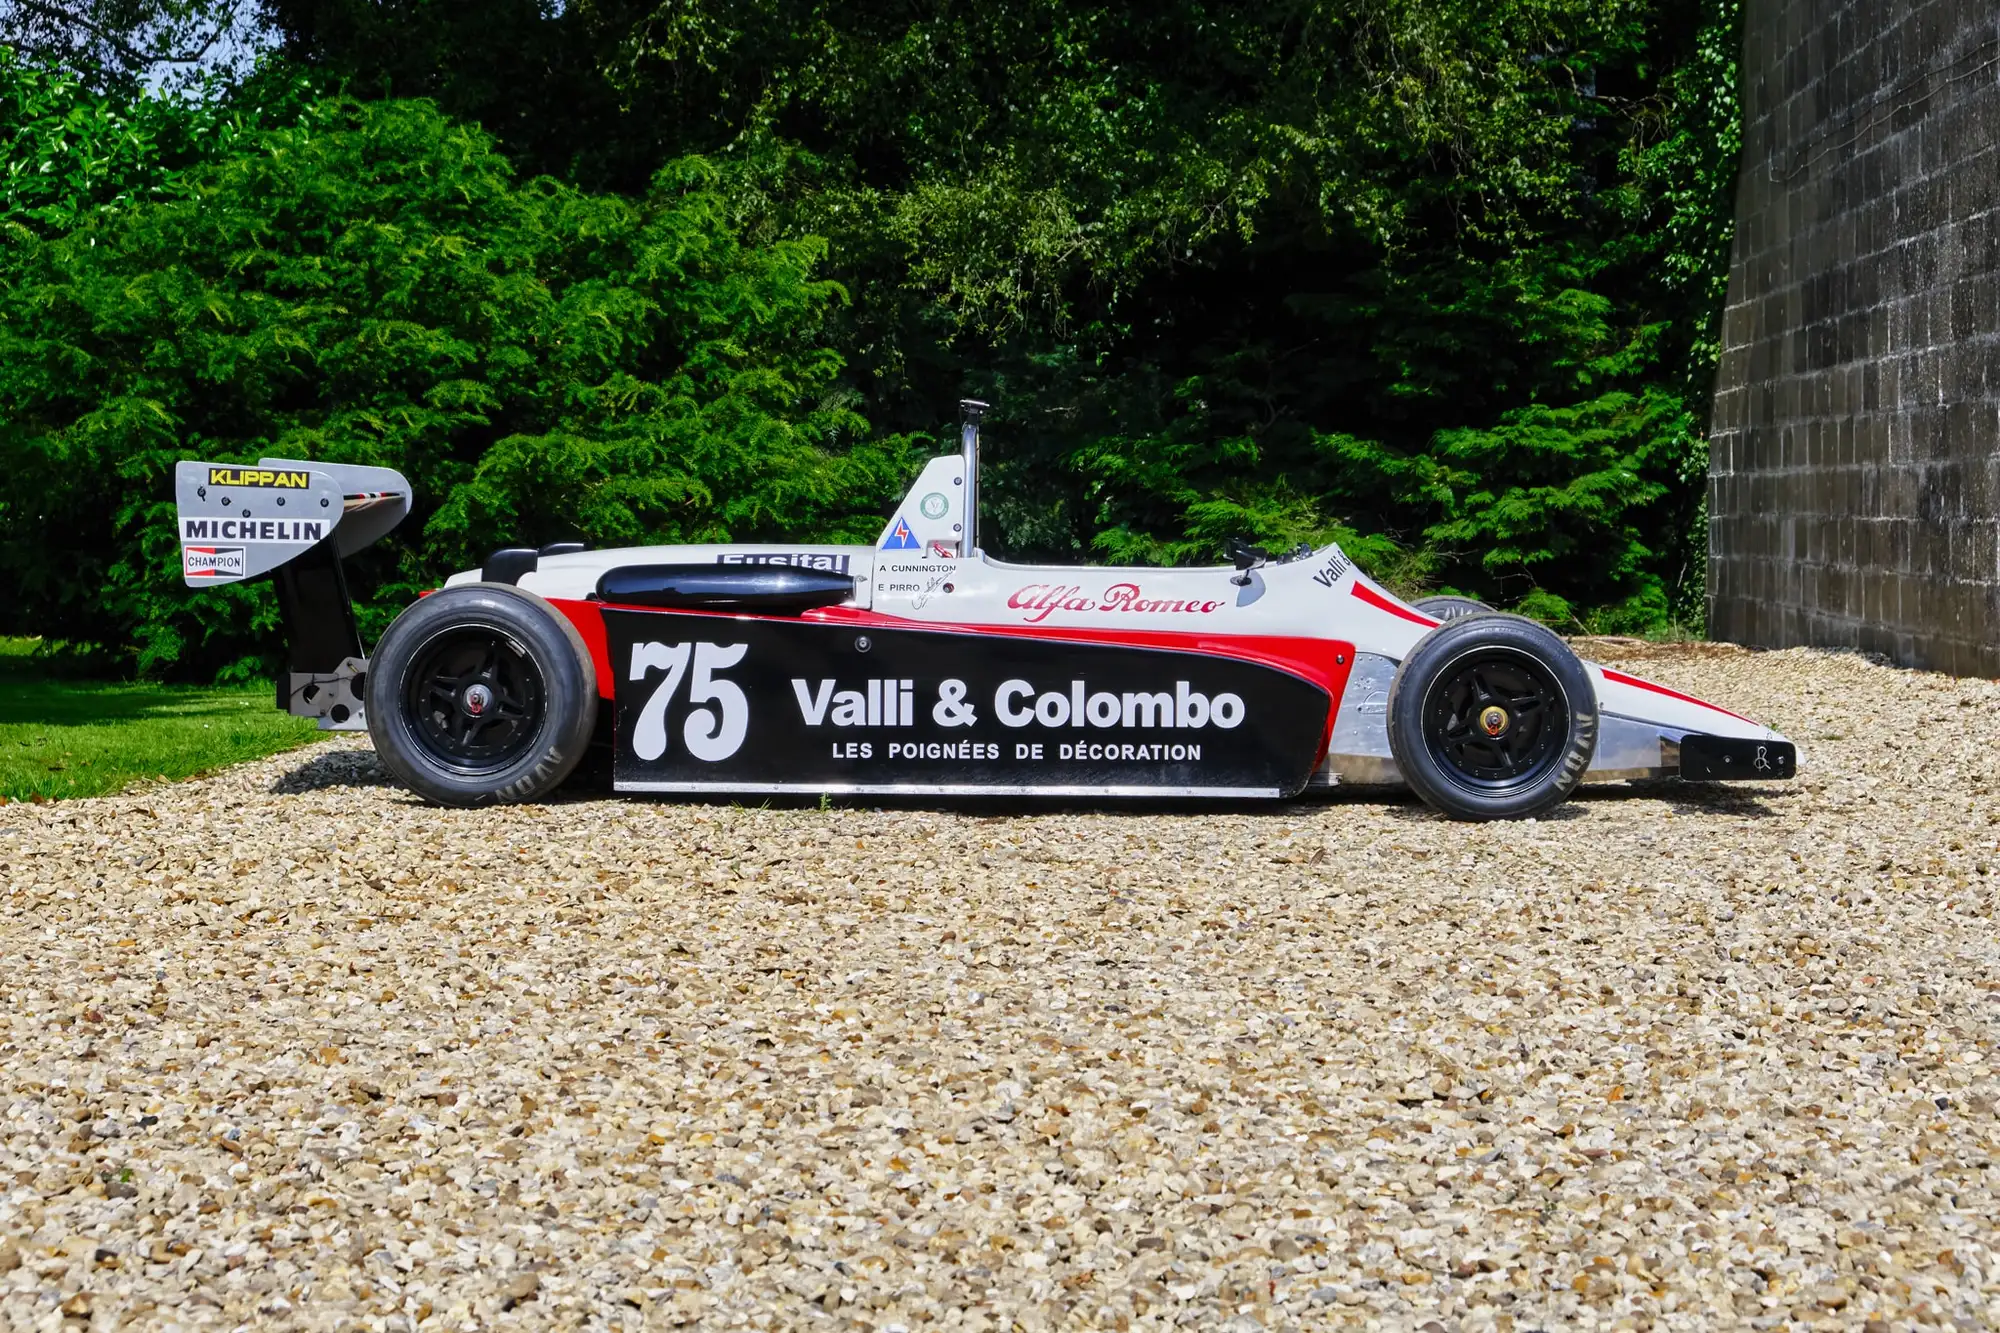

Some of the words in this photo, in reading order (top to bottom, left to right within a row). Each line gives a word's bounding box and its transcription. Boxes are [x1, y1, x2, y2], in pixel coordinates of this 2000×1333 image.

[210, 469, 307, 488] KLIPPAN
[186, 520, 322, 541] MICHELIN
[187, 555, 241, 568] CHAMPION
[879, 564, 887, 572] A
[891, 564, 956, 573] CUNNINGTON
[1312, 555, 1347, 588] Valli
[878, 584, 885, 592] E
[889, 583, 920, 592] PIRRO
[1007, 583, 1096, 623] Alfa
[1098, 582, 1226, 614] Romeo
[628, 641, 749, 762] 75
[791, 678, 914, 727] Valli
[932, 678, 978, 727] &
[994, 678, 1246, 730] Colombo
[832, 742, 873, 759] LES
[888, 738, 1000, 760] POIGNÉES
[1015, 744, 1044, 760] DE
[1060, 740, 1201, 761] DÉCORATION
[495, 745, 563, 804] AVON
